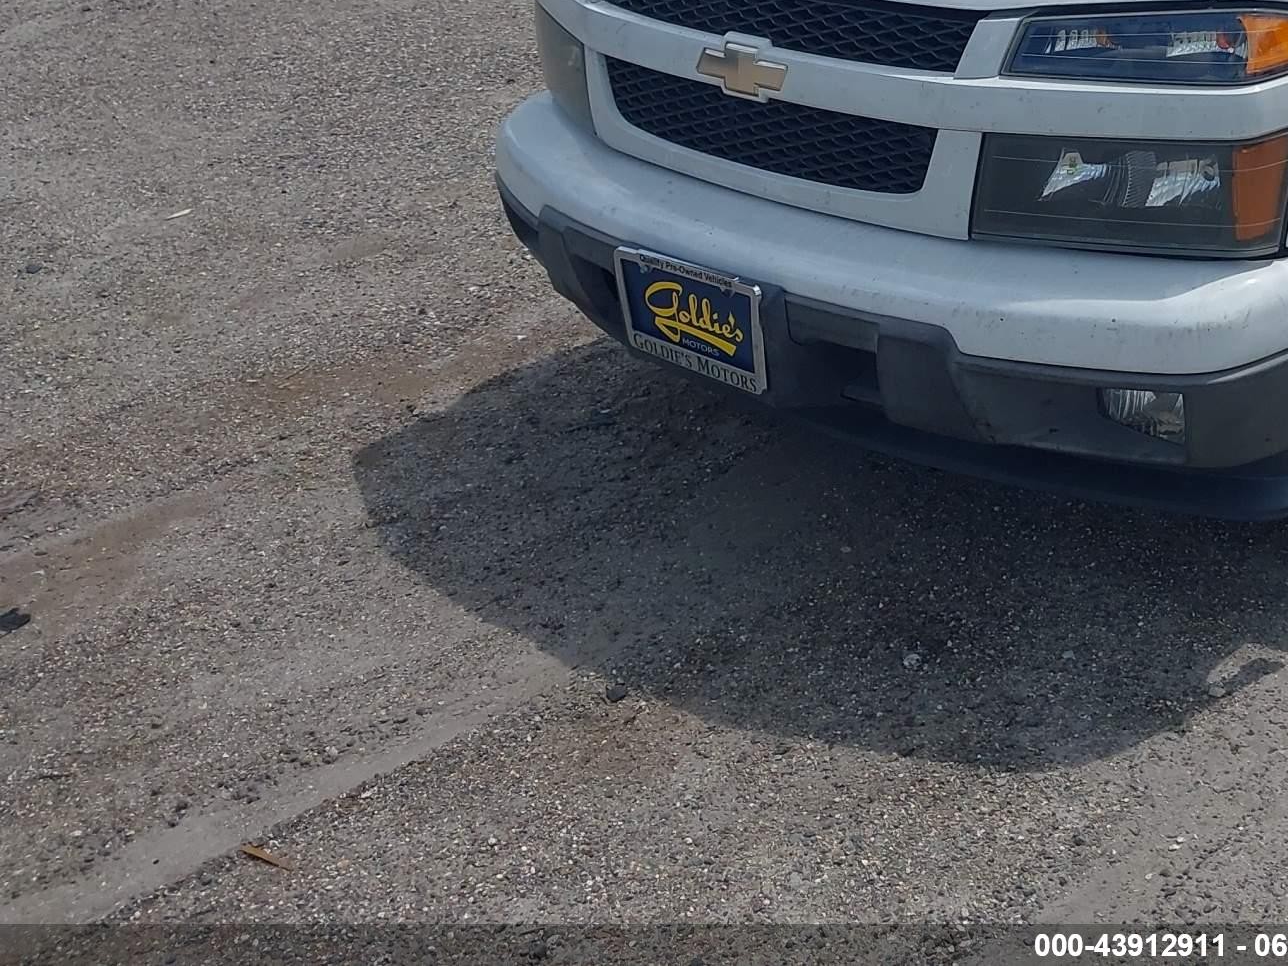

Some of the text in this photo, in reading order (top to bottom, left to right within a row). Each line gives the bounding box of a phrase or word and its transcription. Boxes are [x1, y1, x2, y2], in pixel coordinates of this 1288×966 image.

[665, 261, 703, 280] Pre-Owned
[703, 271, 732, 288] Vehicles
[682, 337, 720, 357] MOTORS
[633, 333, 757, 393] GOLDIE'S MOTORS
